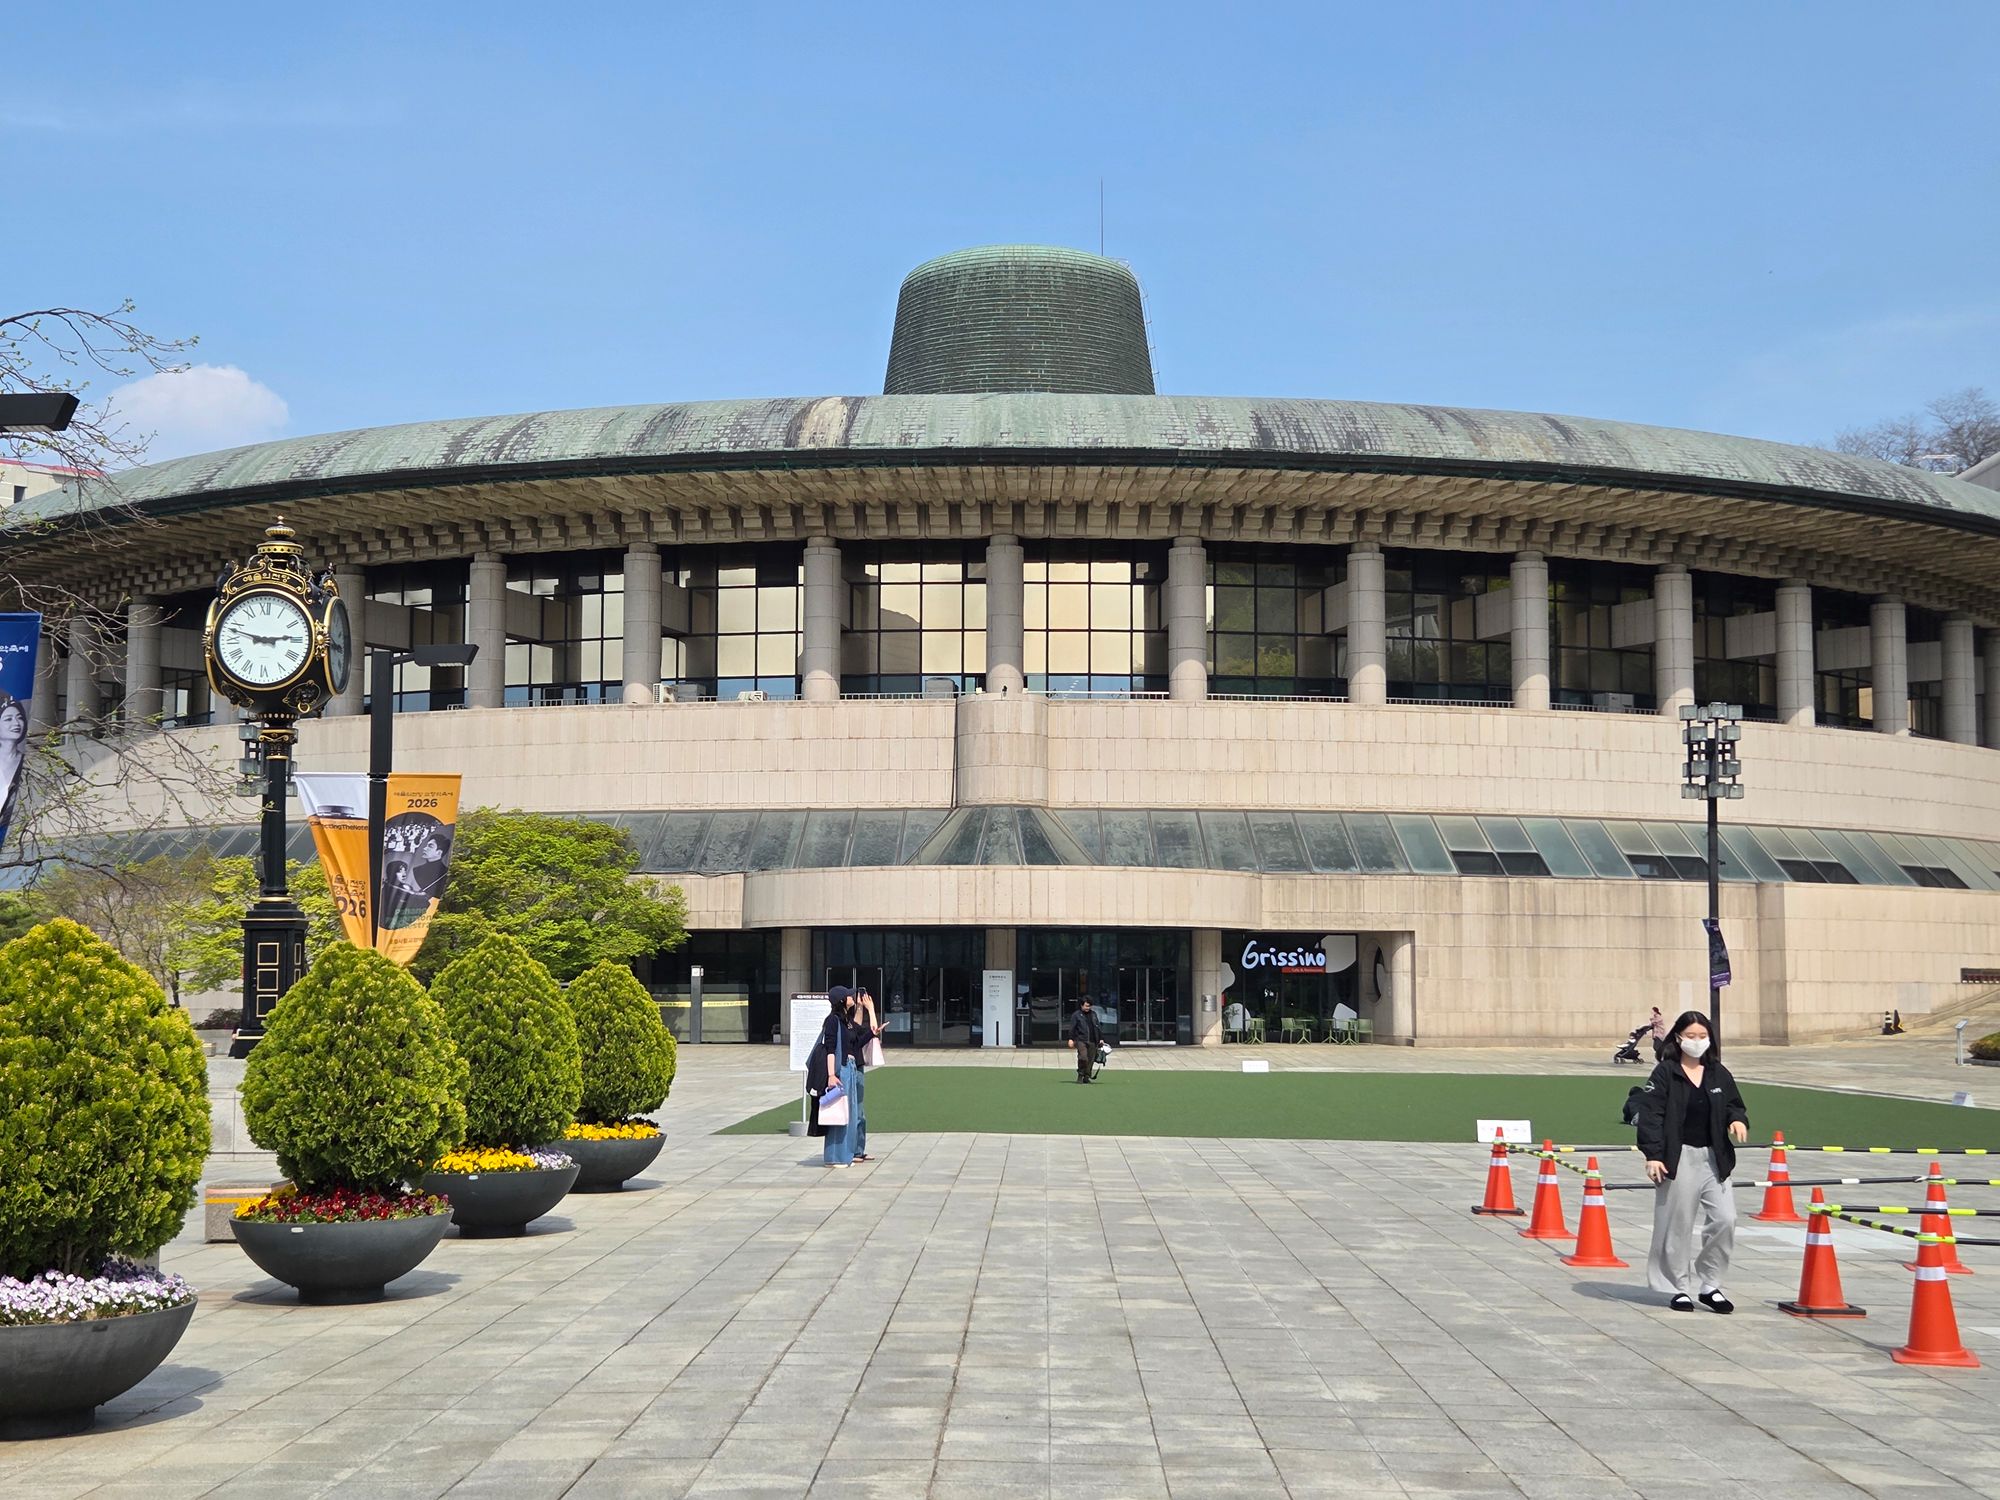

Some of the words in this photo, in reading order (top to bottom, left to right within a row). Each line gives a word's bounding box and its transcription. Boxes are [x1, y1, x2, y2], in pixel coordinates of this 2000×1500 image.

[243, 573, 290, 583] 예술의전당
[243, 605, 256, 619] XI
[260, 603, 271, 615] XII
[286, 620, 299, 629] II
[226, 635, 240, 644] IX
[241, 659, 253, 675] VII
[260, 664, 269, 678] VI
[407, 799, 438, 808] 2026
[335, 896, 366, 918] 026
[1242, 940, 1326, 969] Grissino
